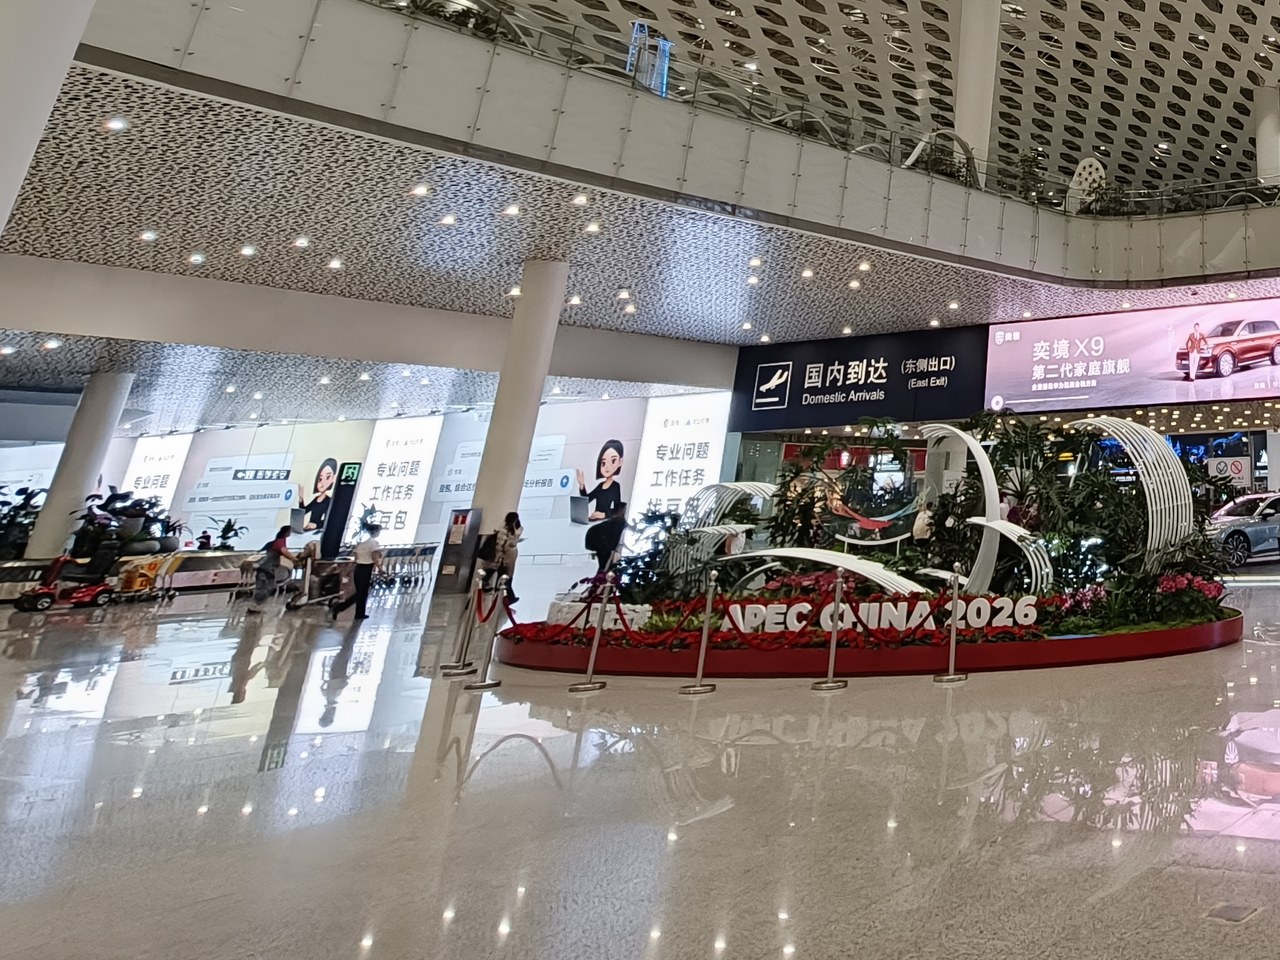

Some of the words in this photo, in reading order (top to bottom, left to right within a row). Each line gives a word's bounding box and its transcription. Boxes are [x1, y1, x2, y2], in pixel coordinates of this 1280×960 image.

[1032, 339, 1070, 361] 奕境
[1074, 336, 1105, 358] X9
[804, 357, 888, 389] 国内到达
[901, 355, 956, 375] (东侧出口)
[1031, 358, 1131, 381] 第二代家庭旗舰
[908, 377, 929, 390] (East
[930, 376, 948, 389] Exit)
[802, 391, 846, 406] Domestic
[848, 388, 885, 402] Arrivals
[656, 442, 711, 461] 专业问题
[377, 460, 421, 478] 专业问题
[650, 468, 706, 487] 工作任务
[369, 484, 414, 502] 工作任务
[720, 601, 813, 633] APEC
[819, 599, 937, 633] CHINA
[944, 595, 1038, 630] 2026
